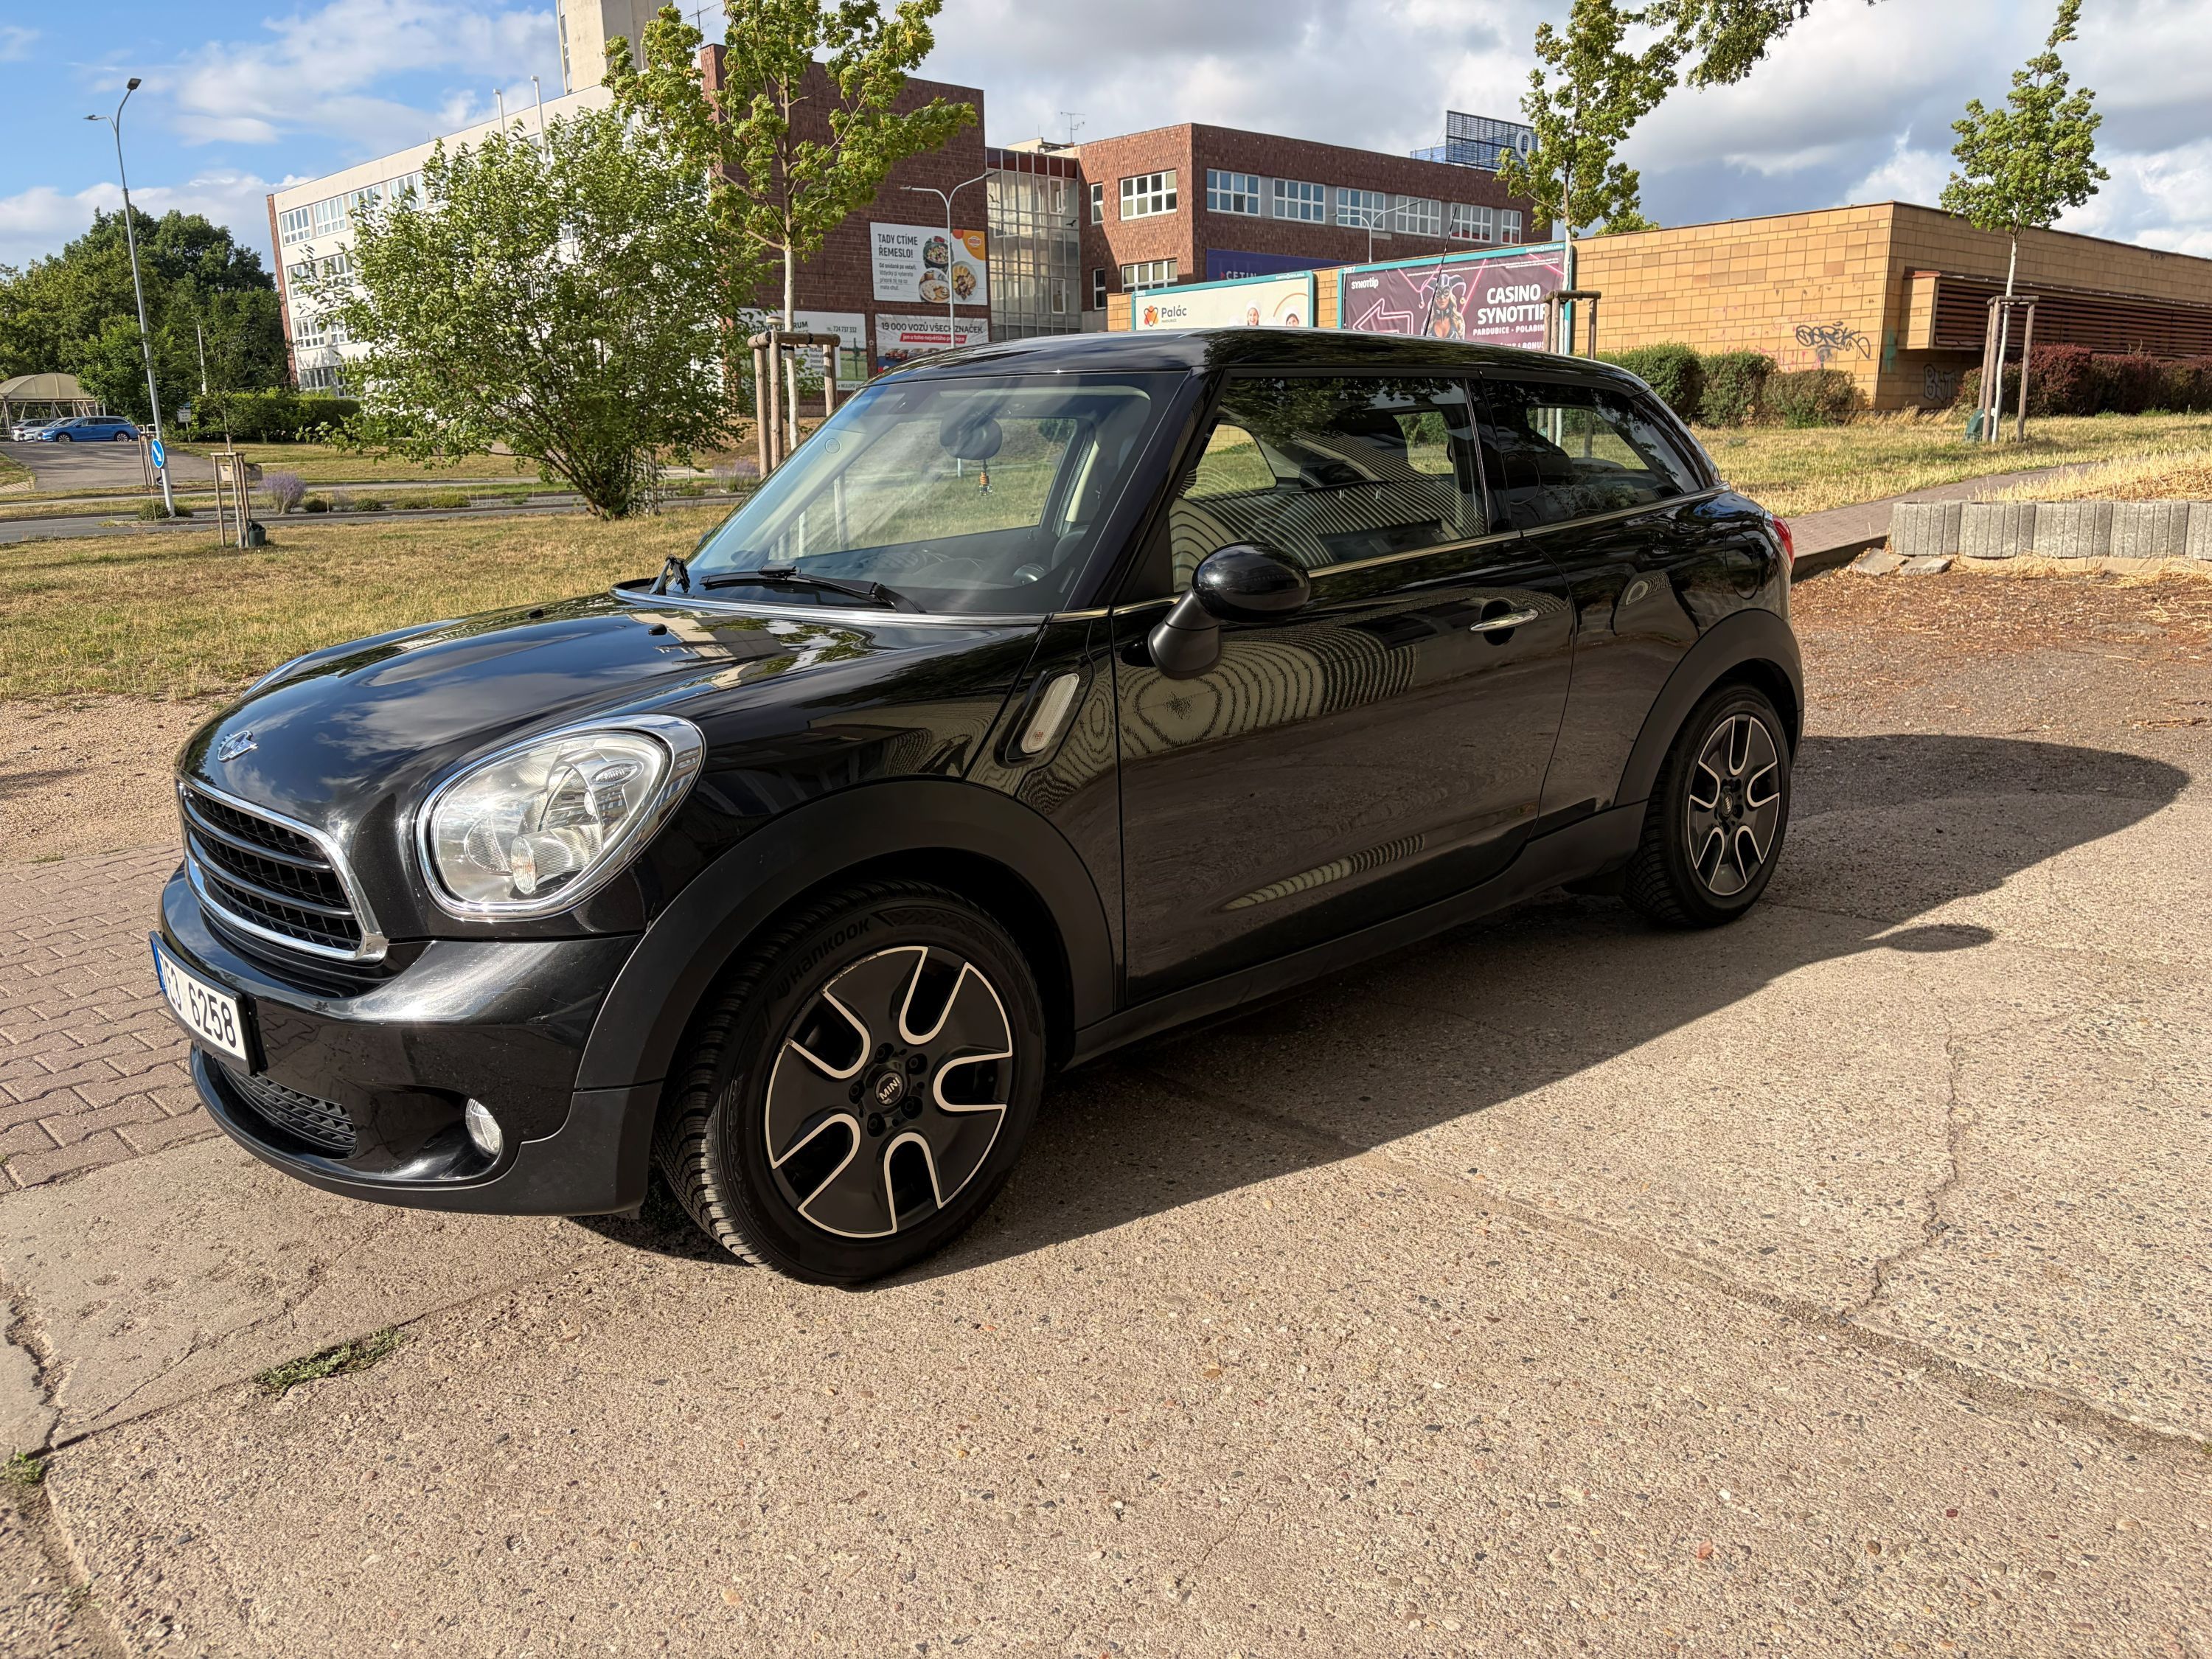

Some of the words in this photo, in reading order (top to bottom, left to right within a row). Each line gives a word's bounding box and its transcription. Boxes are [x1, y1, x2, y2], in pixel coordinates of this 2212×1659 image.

[877, 234, 894, 243] TADY
[897, 234, 918, 246] CTÍME
[879, 245, 914, 258] ŘEMESLO!
[1486, 284, 1541, 305] CASINO
[1161, 305, 1187, 318] Palác
[891, 322, 907, 331] 000
[908, 321, 928, 332] VOZŮ
[1473, 327, 1510, 336] PARDUBICE
[188, 981, 237, 1048] 6258
[879, 1077, 900, 1100] MINI
